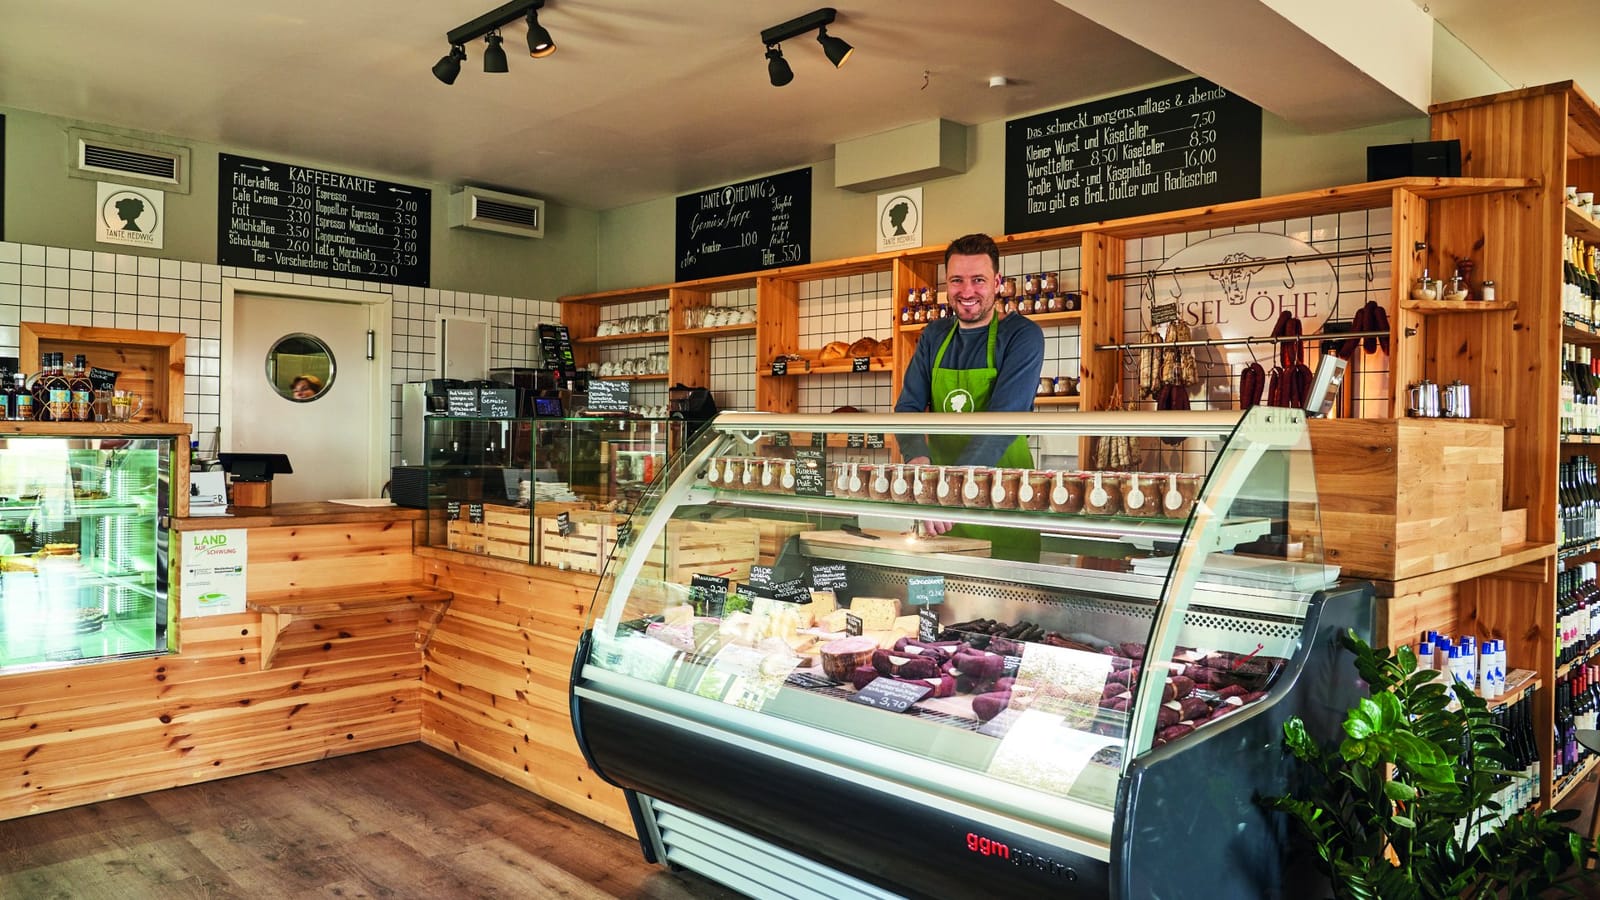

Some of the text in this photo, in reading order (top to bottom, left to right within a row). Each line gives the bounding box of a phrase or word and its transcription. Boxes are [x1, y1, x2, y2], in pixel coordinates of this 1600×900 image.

[1027, 127, 1043, 140] Das
[1046, 111, 1088, 135] schmeckt
[1137, 97, 1171, 115] mittags
[1174, 94, 1183, 107] &
[1188, 84, 1226, 104] abends
[1026, 144, 1052, 161] Kleiner
[1054, 133, 1080, 155] Wurst
[1084, 128, 1099, 150] und
[1104, 120, 1149, 145] Käseteller
[1122, 138, 1165, 160] Käseteller
[1026, 155, 1074, 178] Wurstteller
[233, 172, 280, 191] Filterkaffee
[289, 167, 377, 194] KAFFEEKARTE
[1027, 177, 1051, 196] Große
[1086, 166, 1101, 186] und
[1106, 158, 1151, 182] Käseplatte
[253, 189, 278, 206] Crema
[316, 186, 347, 202] Espresso
[1027, 197, 1047, 214] Dazu
[1049, 191, 1066, 214] gibt
[1069, 195, 1080, 207] es
[1108, 179, 1139, 201] Butter
[1141, 174, 1159, 196] und
[1164, 165, 1217, 192] Radieschen
[232, 201, 250, 217] Pott
[315, 200, 348, 216] Doppelter
[351, 205, 380, 220] Espresso
[700, 191, 720, 210] TANTE
[231, 217, 275, 234] Milchkaffee
[315, 214, 346, 230] Espresso
[349, 219, 384, 235] Macchiato
[106, 229, 125, 239] TANTE
[127, 231, 154, 241] HEDWIG
[229, 234, 270, 249] Schokolade
[315, 227, 356, 245] Cappuccino
[251, 249, 266, 262] Tee
[274, 251, 328, 270] Verschiedene
[332, 256, 361, 273] Sorten
[315, 242, 335, 256] Latte
[338, 245, 376, 261] Macchiato
[1250, 290, 1318, 322] ÖHE
[193, 534, 227, 546] LAND
